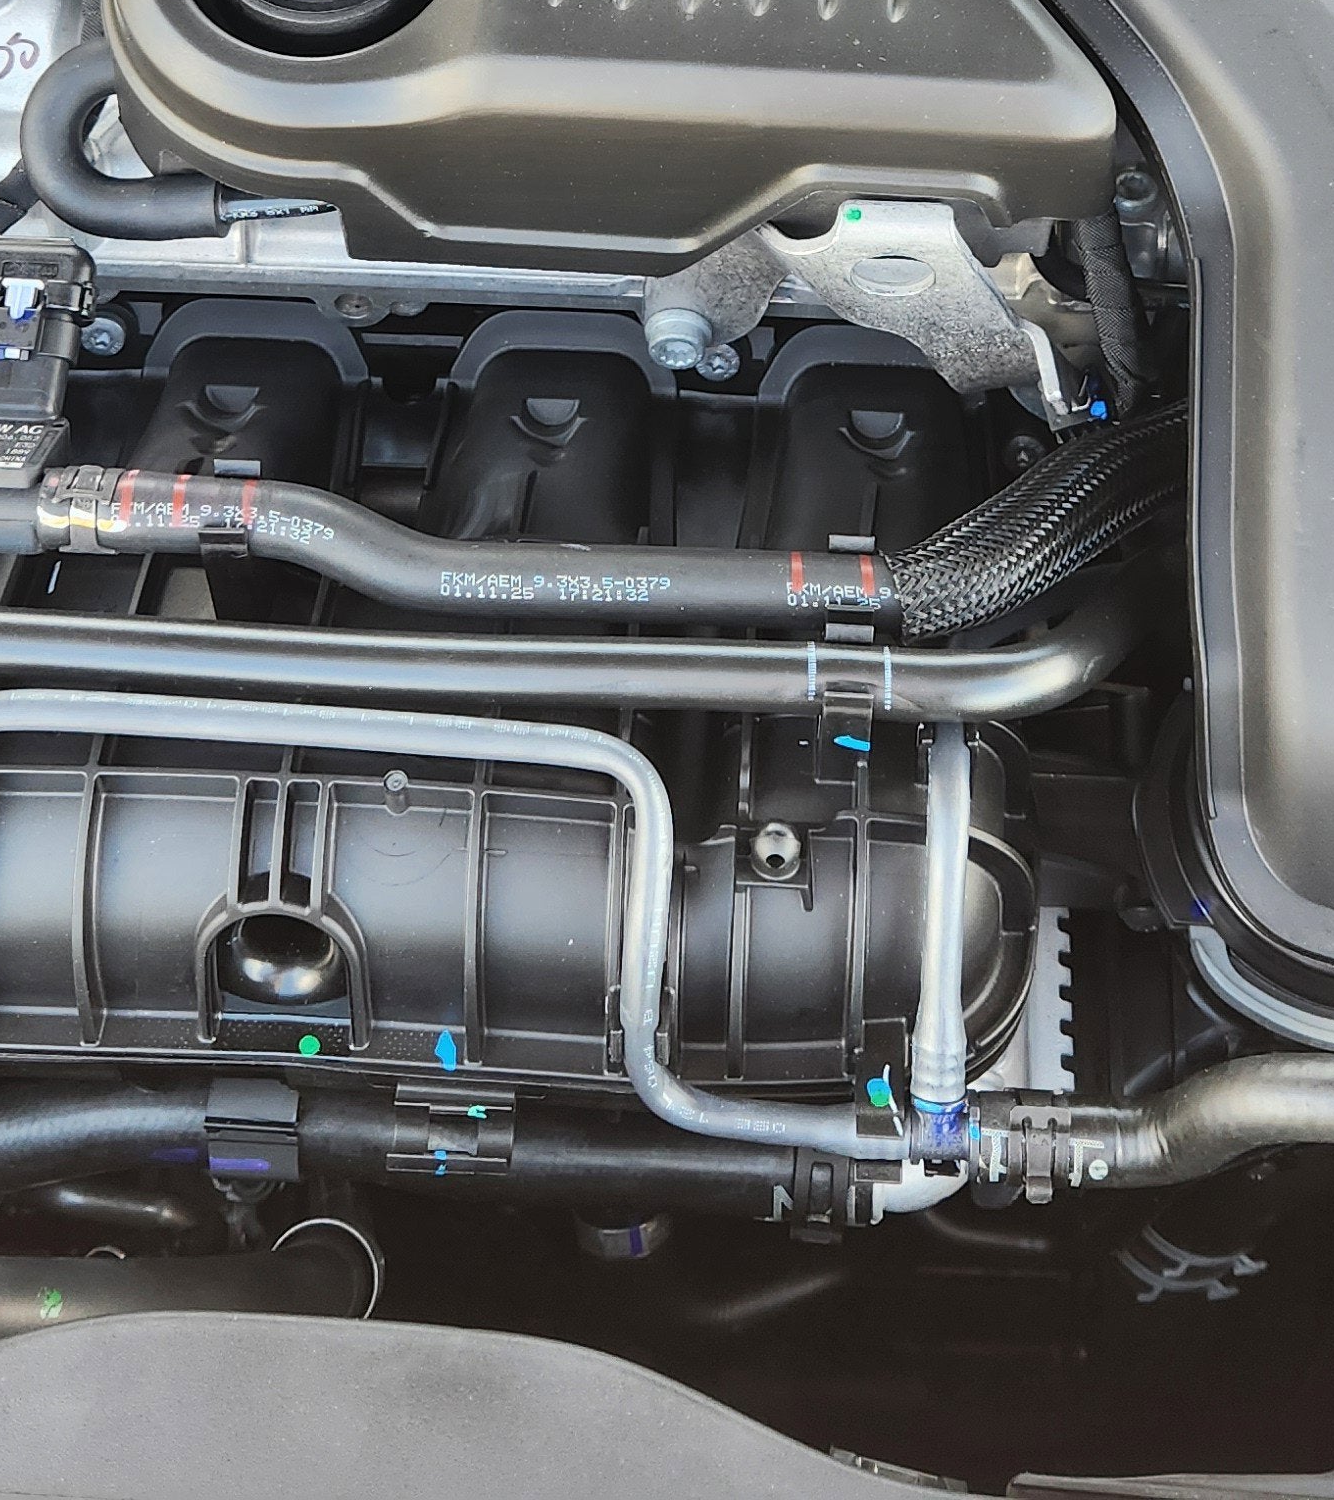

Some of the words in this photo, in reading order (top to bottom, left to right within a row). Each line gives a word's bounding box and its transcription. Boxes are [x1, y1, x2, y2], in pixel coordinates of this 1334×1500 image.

[14, 425, 45, 434] AG
[440, 571, 522, 588] FKM/AEM
[533, 574, 671, 590] 9.3X3.5-0379
[440, 584, 535, 600] 01.11.25
[559, 588, 649, 602] 17:21:32
